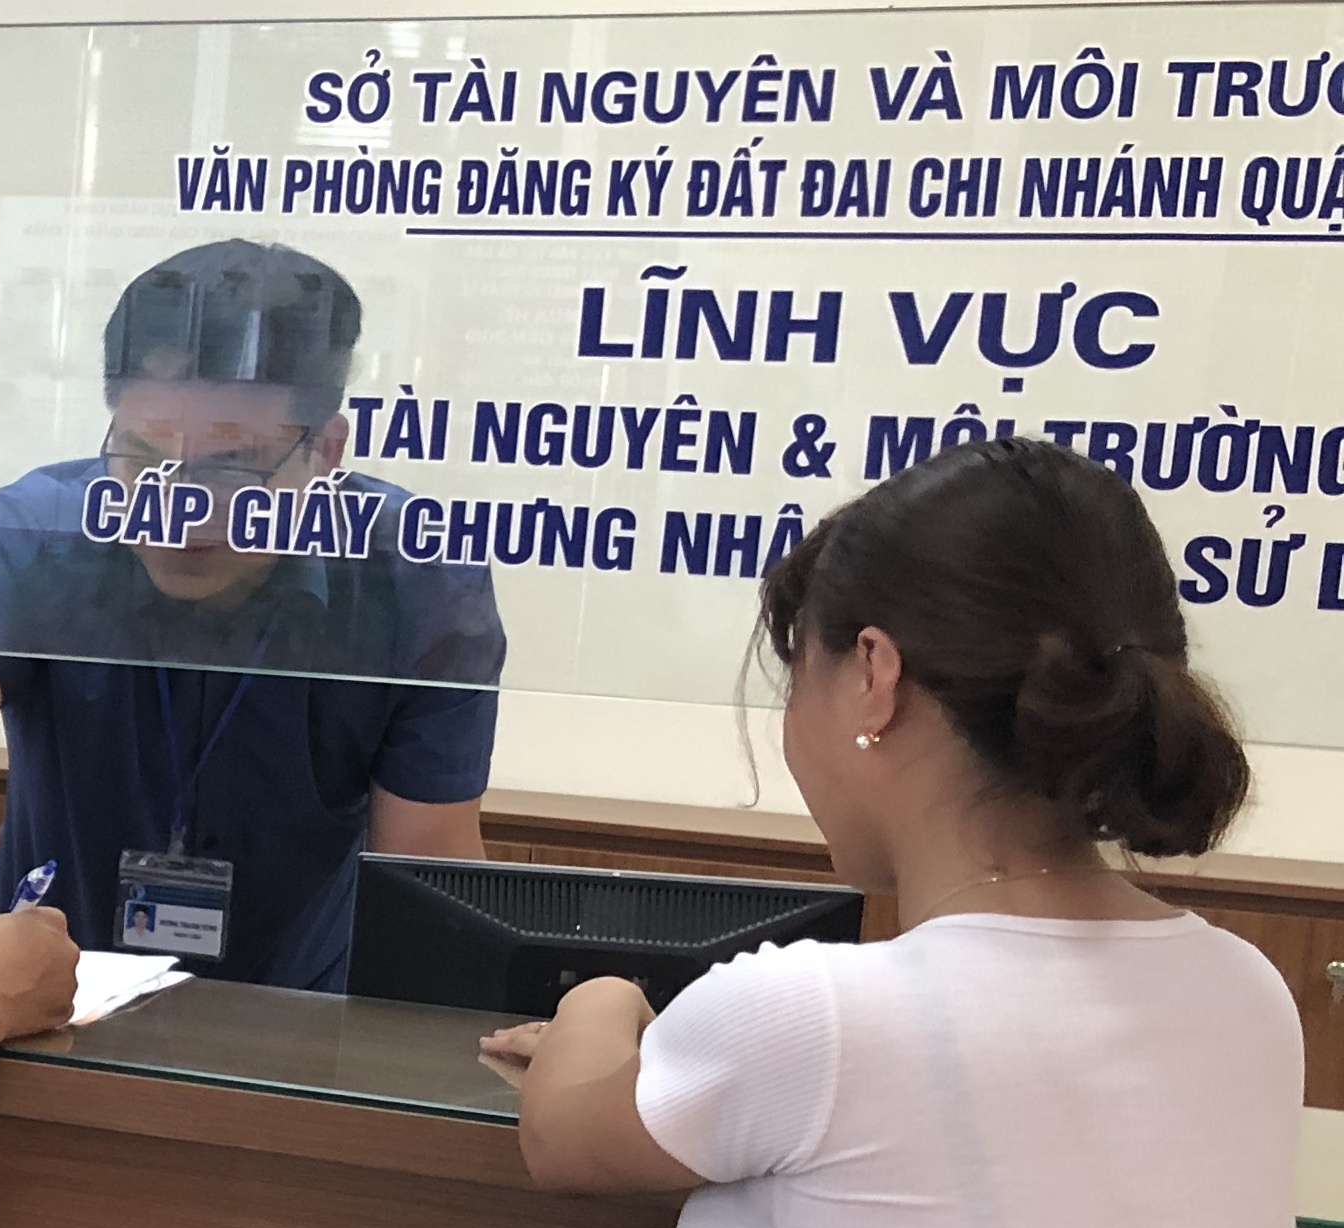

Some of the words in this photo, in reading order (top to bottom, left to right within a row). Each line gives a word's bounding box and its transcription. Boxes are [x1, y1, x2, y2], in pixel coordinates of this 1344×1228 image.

[305, 48, 391, 124] SỞ
[412, 57, 518, 123] TÀI
[539, 53, 836, 125] NGUYÊN
[869, 49, 963, 121] VÀ
[989, 46, 1140, 120] MÔI
[177, 144, 269, 212] VĂN
[281, 144, 443, 215] PHÒNG
[456, 146, 592, 216] ĐĂNG
[606, 144, 674, 217] KÝ
[685, 136, 788, 218] ĐẤT
[799, 158, 892, 218] ĐAI
[908, 157, 1002, 218] CHI
[1018, 143, 1224, 218] NHÁNH
[1239, 143, 1344, 232] QUẬ
[577, 264, 844, 364] LĨNH
[887, 280, 1161, 393] VỰC
[348, 383, 451, 461] TÀI
[470, 393, 758, 475] NGUYÊN
[781, 412, 837, 478] &
[81, 459, 214, 549] CẤP
[227, 469, 387, 559] GIẤY
[659, 502, 805, 579] NHÂ
[1178, 504, 1307, 608] SỬ
